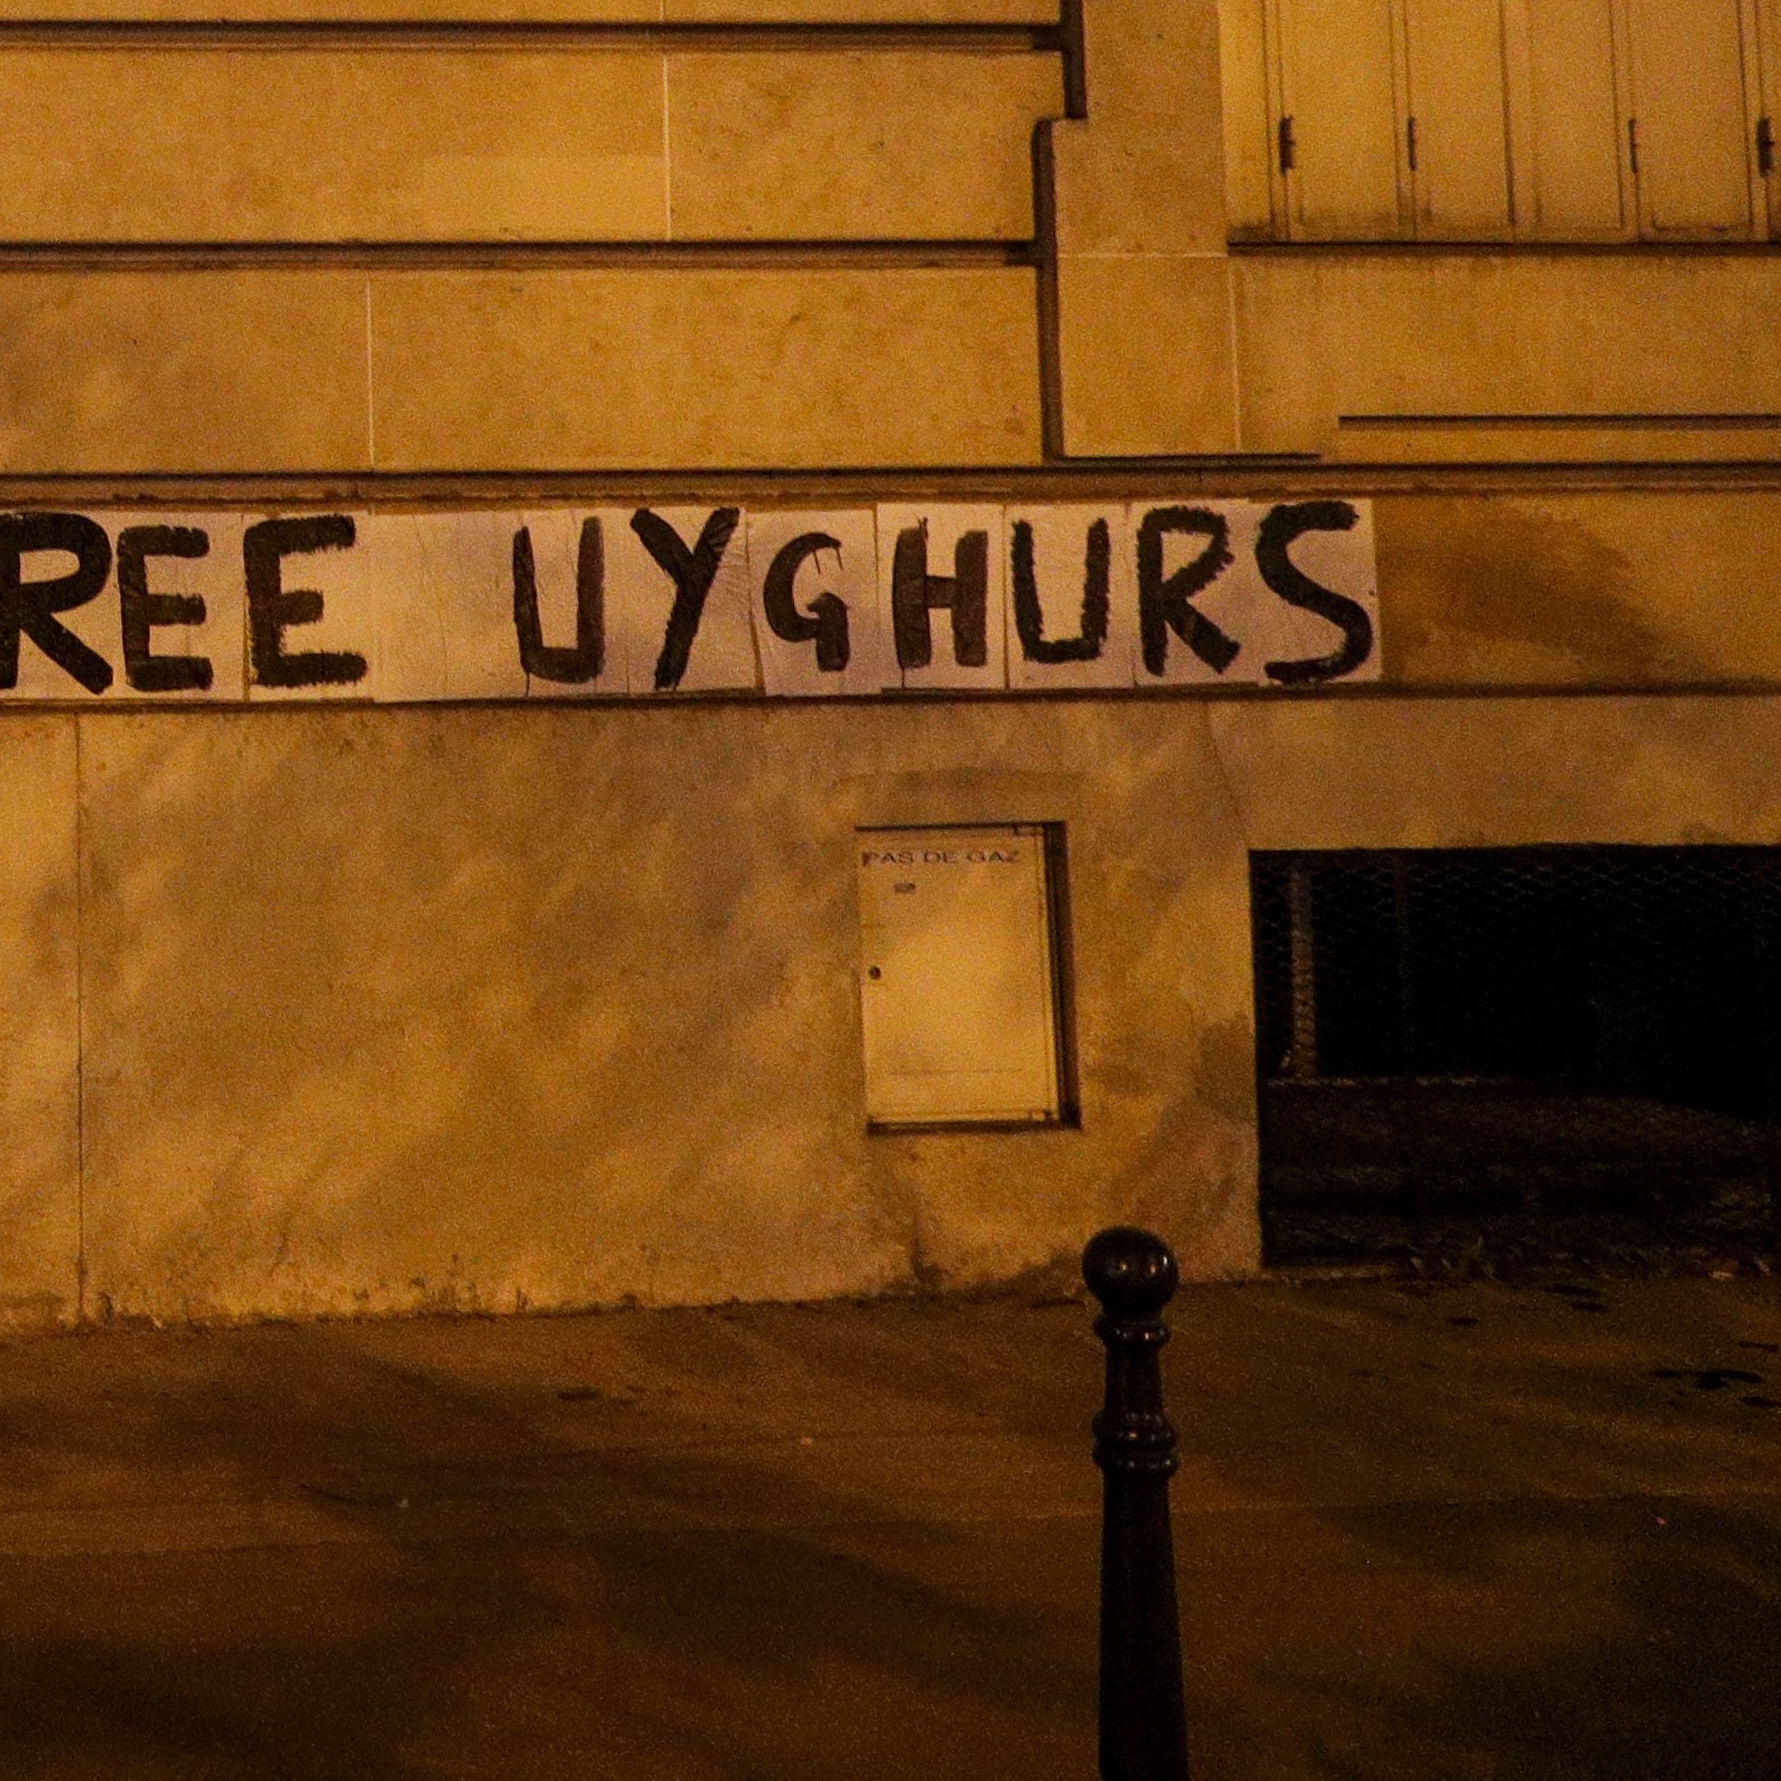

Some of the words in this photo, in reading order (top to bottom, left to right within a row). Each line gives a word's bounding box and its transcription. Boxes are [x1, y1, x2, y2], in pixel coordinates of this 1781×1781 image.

[513, 501, 1376, 692] UYGHURS
[862, 850, 914, 866] PAS
[924, 849, 956, 864] DE
[967, 848, 1020, 864] GAZ
